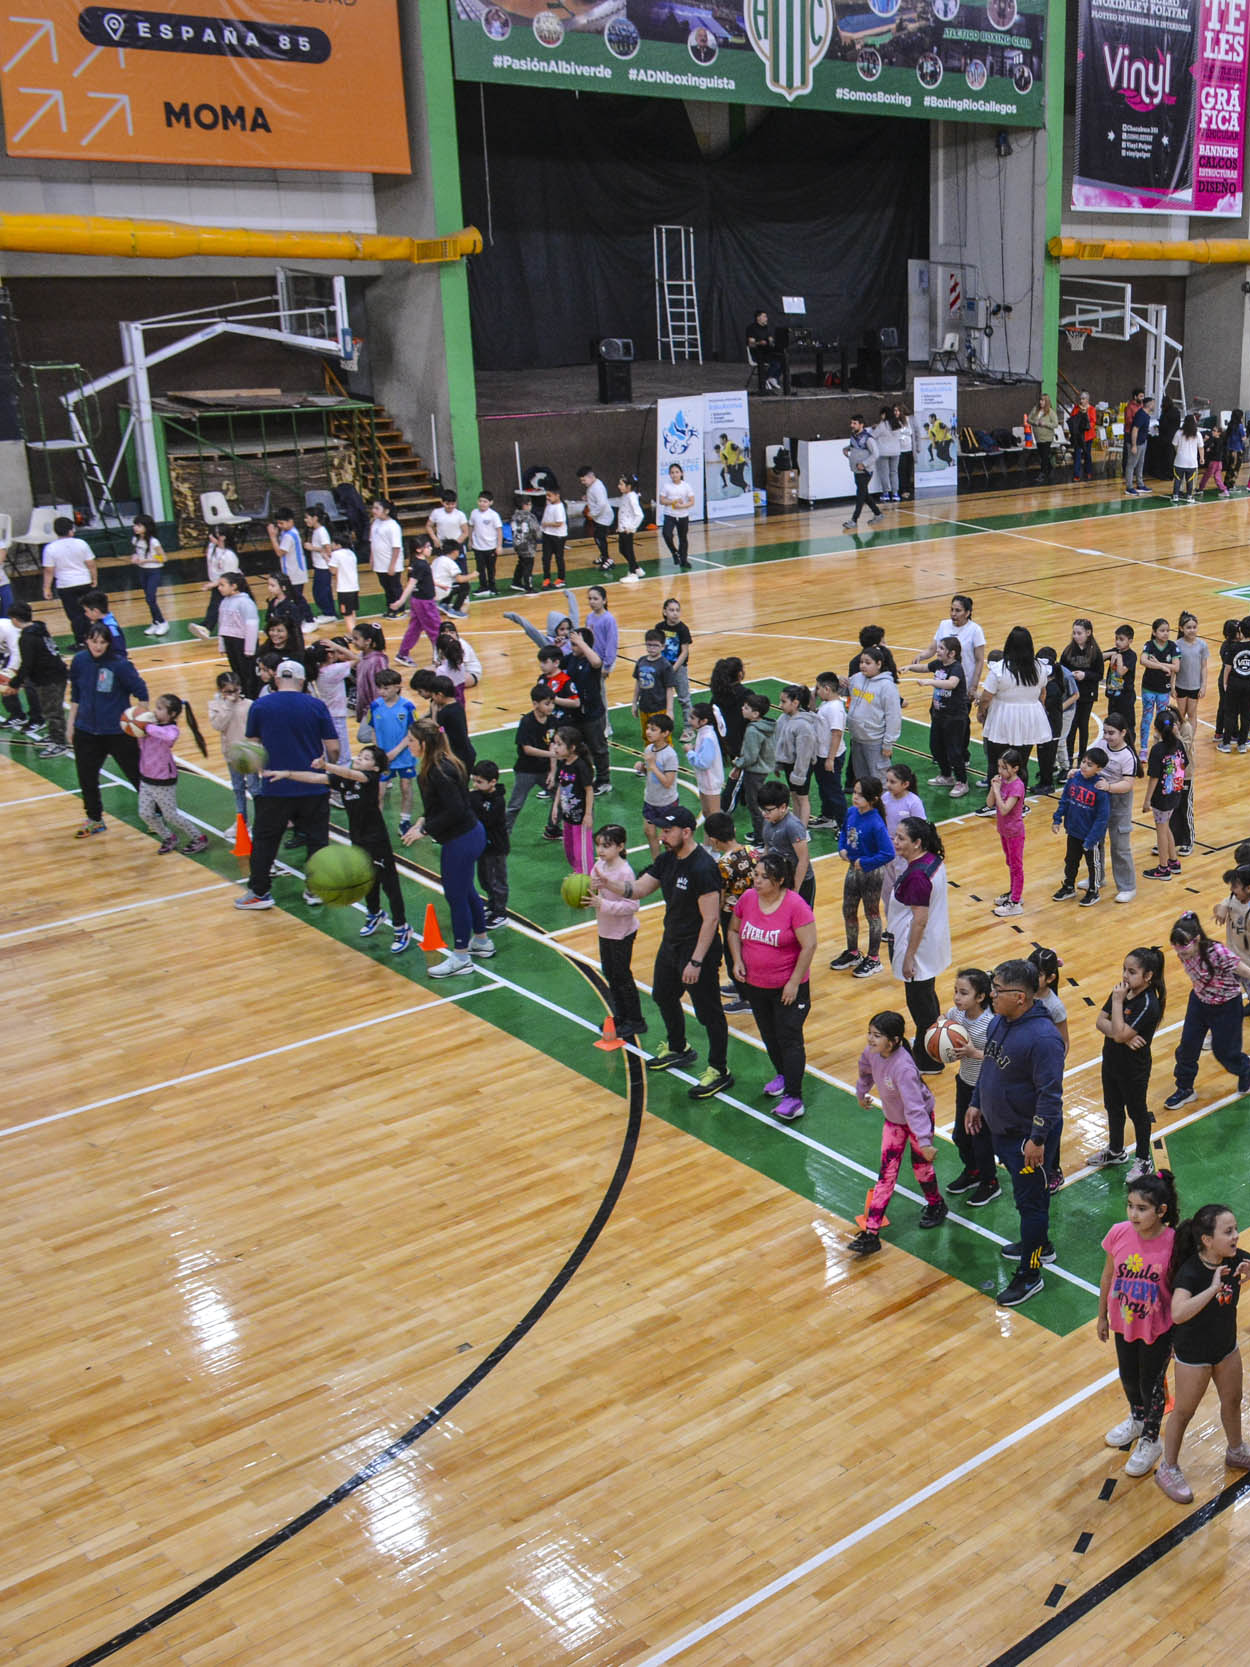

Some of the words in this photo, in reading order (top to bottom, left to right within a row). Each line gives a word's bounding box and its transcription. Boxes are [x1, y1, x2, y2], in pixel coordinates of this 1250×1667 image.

[138, 21, 261, 49] ESPAÑA
[278, 34, 312, 52] 85
[1202, 31, 1245, 62] LES
[492, 54, 612, 79] #PasiónAlbiverde
[628, 67, 736, 90] #ADNboxinguista
[1104, 45, 1171, 105] Vinyl
[836, 87, 912, 108] #SomosBoxing
[1200, 83, 1241, 112] GRÁ
[163, 101, 273, 134] MOMA
[1199, 109, 1240, 132] FICA
[1198, 144, 1239, 158] BANNERS
[1198, 156, 1238, 169] CALCOS
[1198, 178, 1237, 194] DISEÑO
[741, 920, 781, 948] EVERLAST
[1117, 1263, 1161, 1283] Smile
